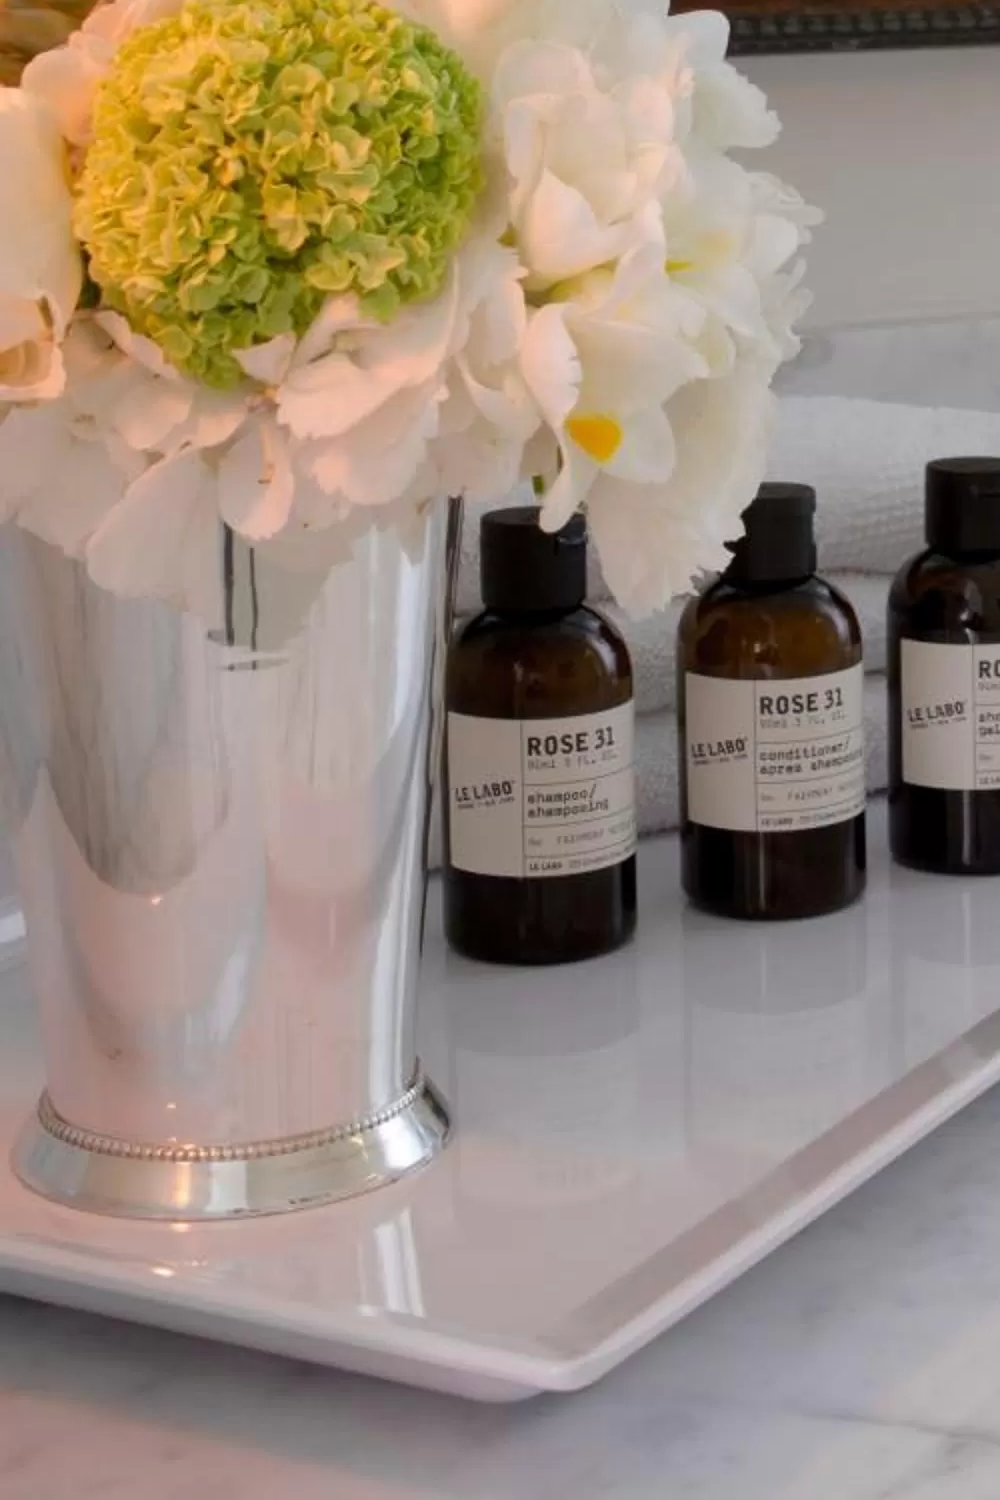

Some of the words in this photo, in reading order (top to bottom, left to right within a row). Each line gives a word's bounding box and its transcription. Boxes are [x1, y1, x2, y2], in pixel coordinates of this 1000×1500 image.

[760, 692, 818, 715] ROSE
[824, 687, 843, 709] 31
[907, 708, 924, 722] LE
[926, 701, 964, 720] LABO
[527, 732, 589, 756] ROSE
[594, 726, 615, 749] 31
[691, 743, 705, 758] LE
[707, 738, 745, 757] LABO
[455, 787, 470, 802] LE
[473, 780, 513, 799] LABO
[527, 783, 597, 805] shampoo/
